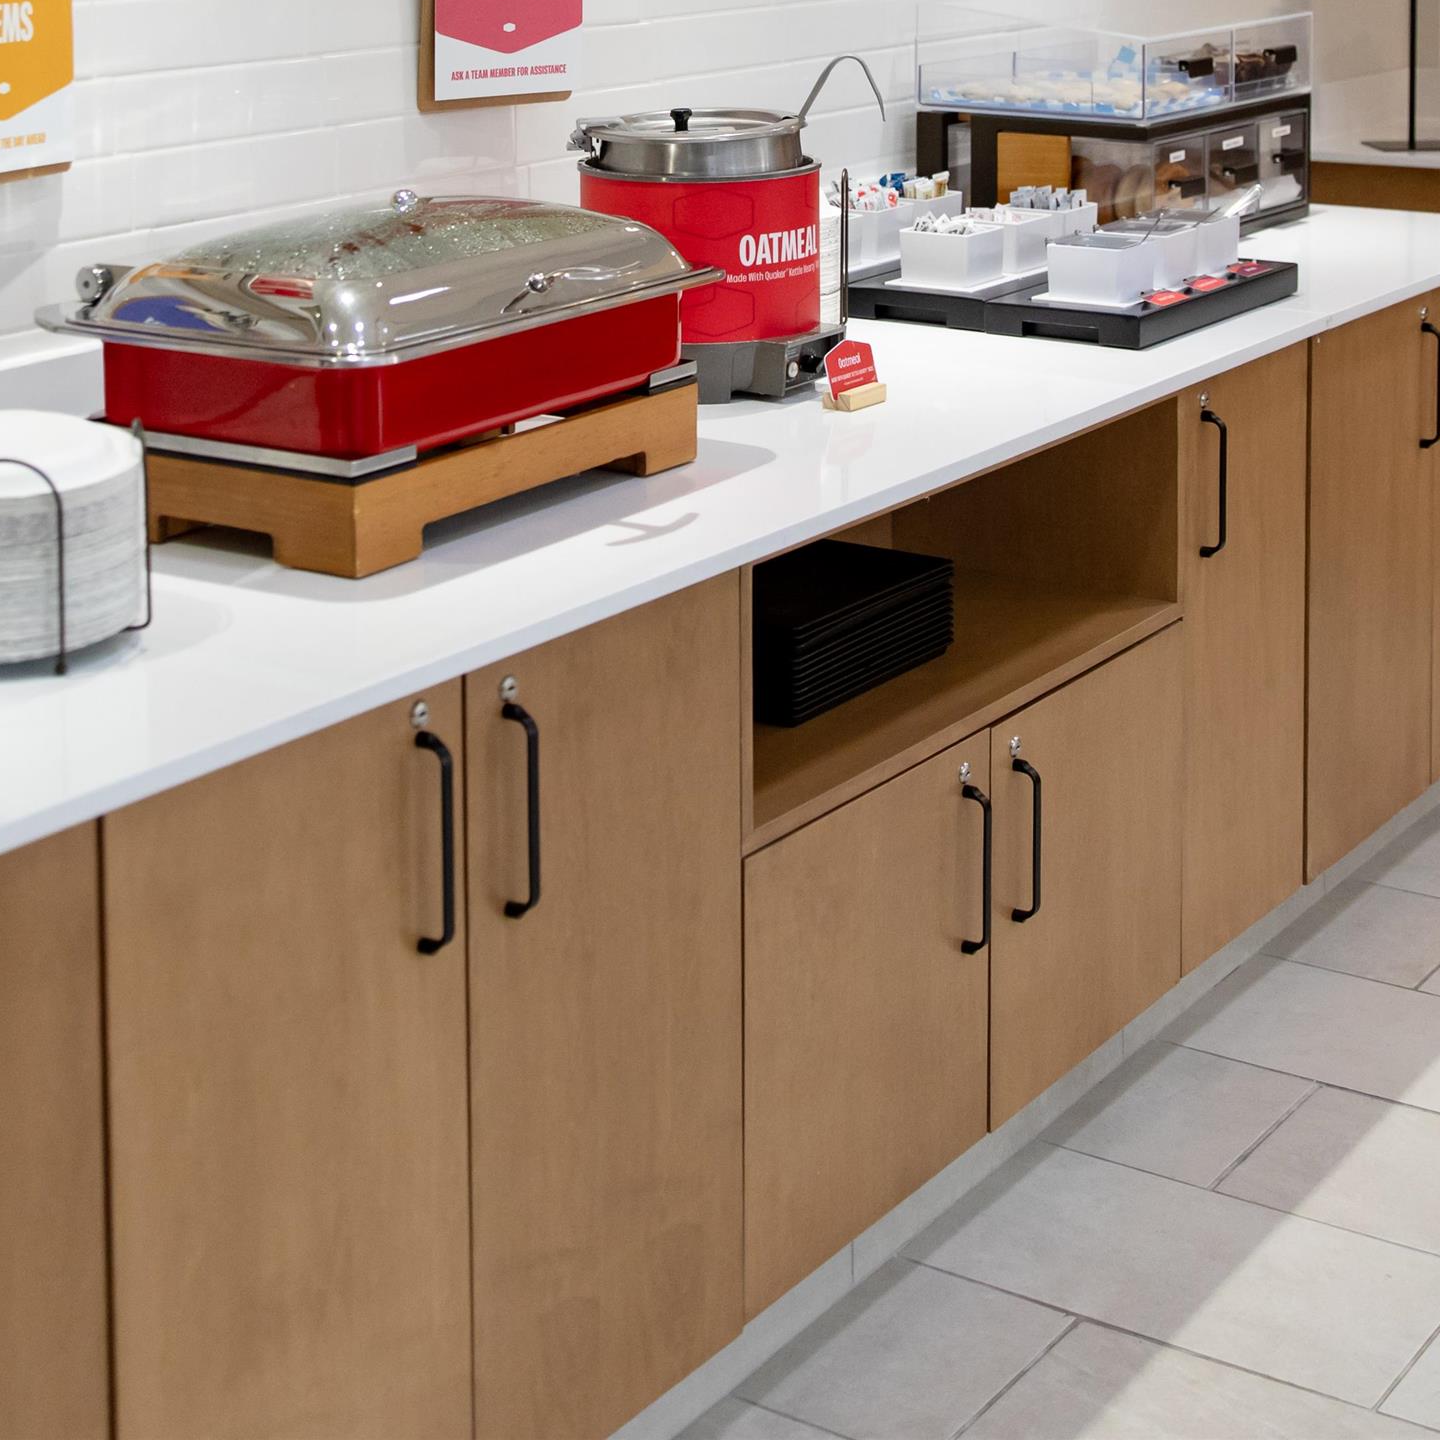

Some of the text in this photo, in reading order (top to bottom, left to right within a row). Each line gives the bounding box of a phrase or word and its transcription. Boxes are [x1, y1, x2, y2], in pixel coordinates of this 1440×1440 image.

[451, 63, 567, 81] ASK A TEAM MEMBER FOR ASSISTANCE
[738, 224, 818, 267] OATMEAL
[726, 274, 747, 283] Made
[748, 272, 764, 282] With
